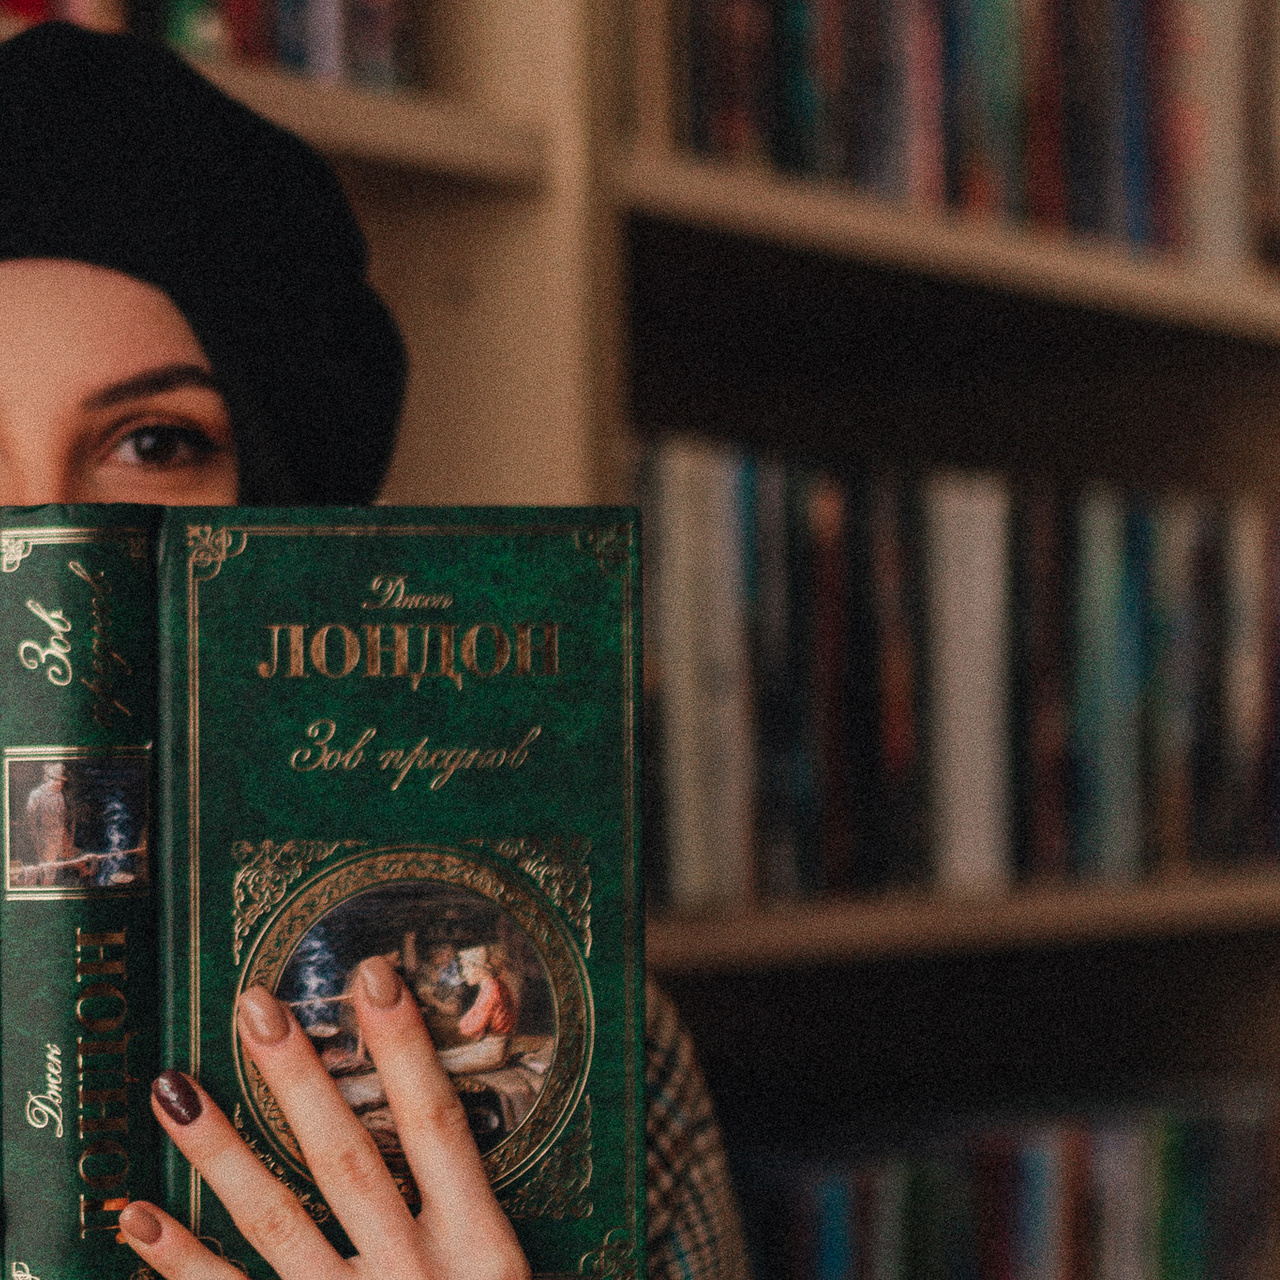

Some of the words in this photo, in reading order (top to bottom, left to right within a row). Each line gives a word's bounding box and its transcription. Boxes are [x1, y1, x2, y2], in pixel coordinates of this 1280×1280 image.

[361, 572, 454, 610] Джек
[17, 597, 73, 688] Зов
[256, 622, 562, 692] ЛОНДОН
[288, 718, 378, 772] Зов
[377, 724, 543, 793] предков
[24, 1042, 65, 1140] Джек
[75, 925, 140, 1244] ЛОНДОН
